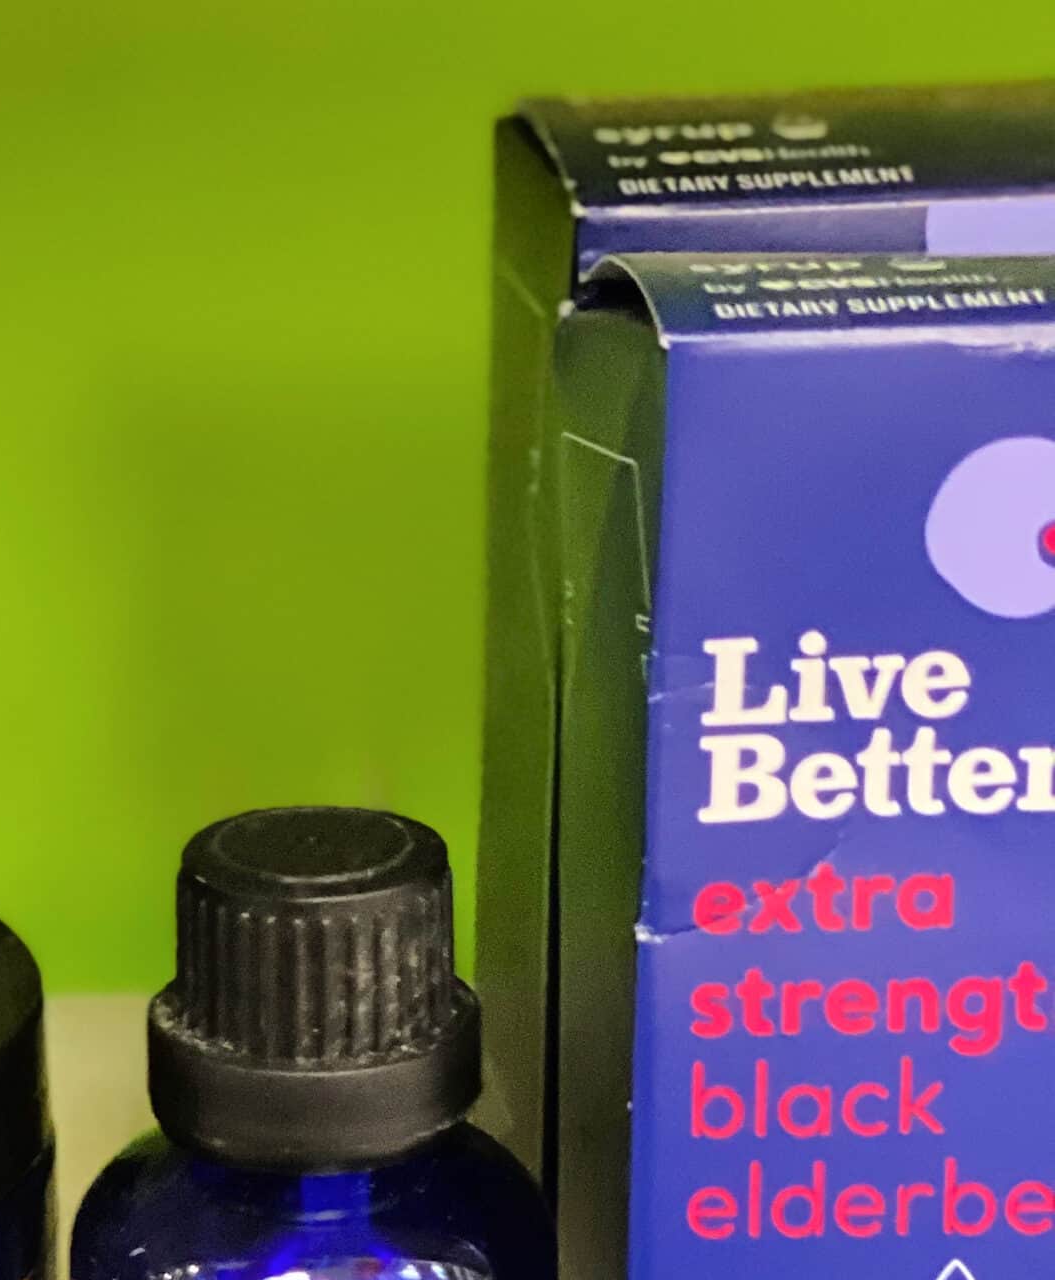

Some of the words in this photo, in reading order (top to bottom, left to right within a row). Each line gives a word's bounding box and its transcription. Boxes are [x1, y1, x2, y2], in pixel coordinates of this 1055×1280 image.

[618, 174, 729, 196] DIETARY
[735, 165, 914, 190] SUPPLEMENT
[713, 300, 839, 319] DIETARY
[846, 288, 1045, 313] SUPPLEMENT
[701, 630, 971, 726] Live
[697, 726, 1055, 823] Better
[692, 862, 955, 934] extra
[691, 1056, 944, 1138] black
